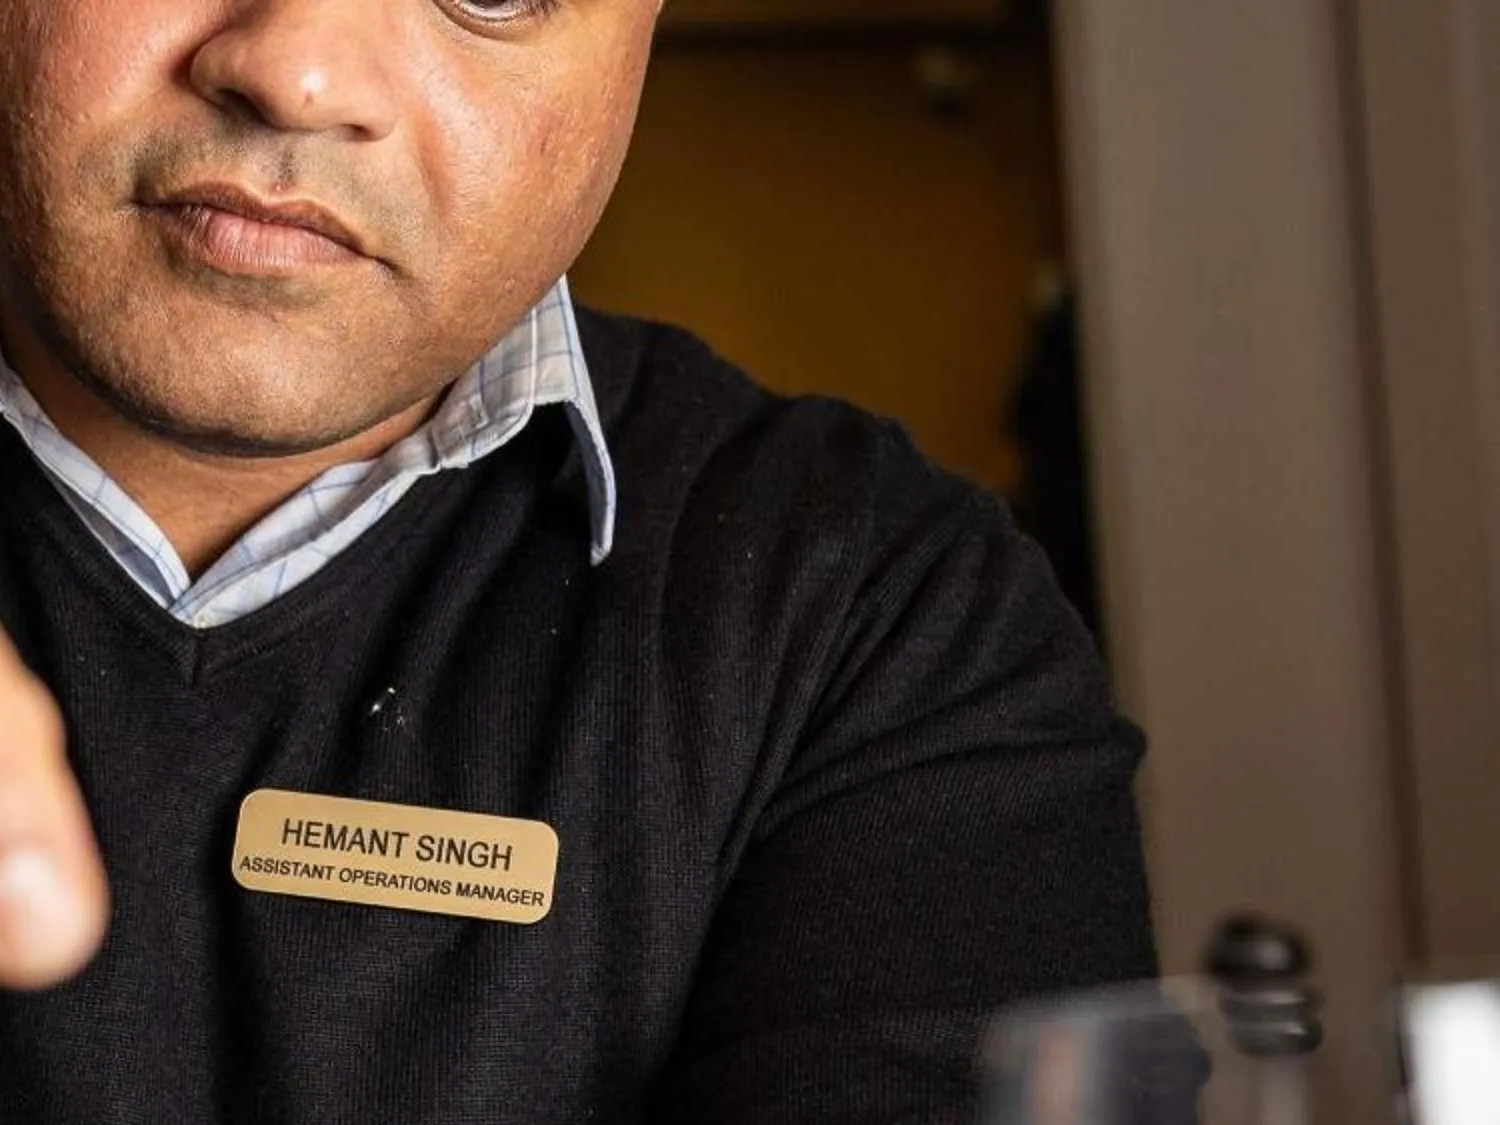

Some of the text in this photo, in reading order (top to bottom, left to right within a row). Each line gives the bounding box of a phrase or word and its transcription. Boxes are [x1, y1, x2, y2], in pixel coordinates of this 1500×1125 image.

[281, 818, 513, 871] HEMANT SINGH
[240, 855, 545, 907] ASSISTANT OPERATIONS MANAGER
